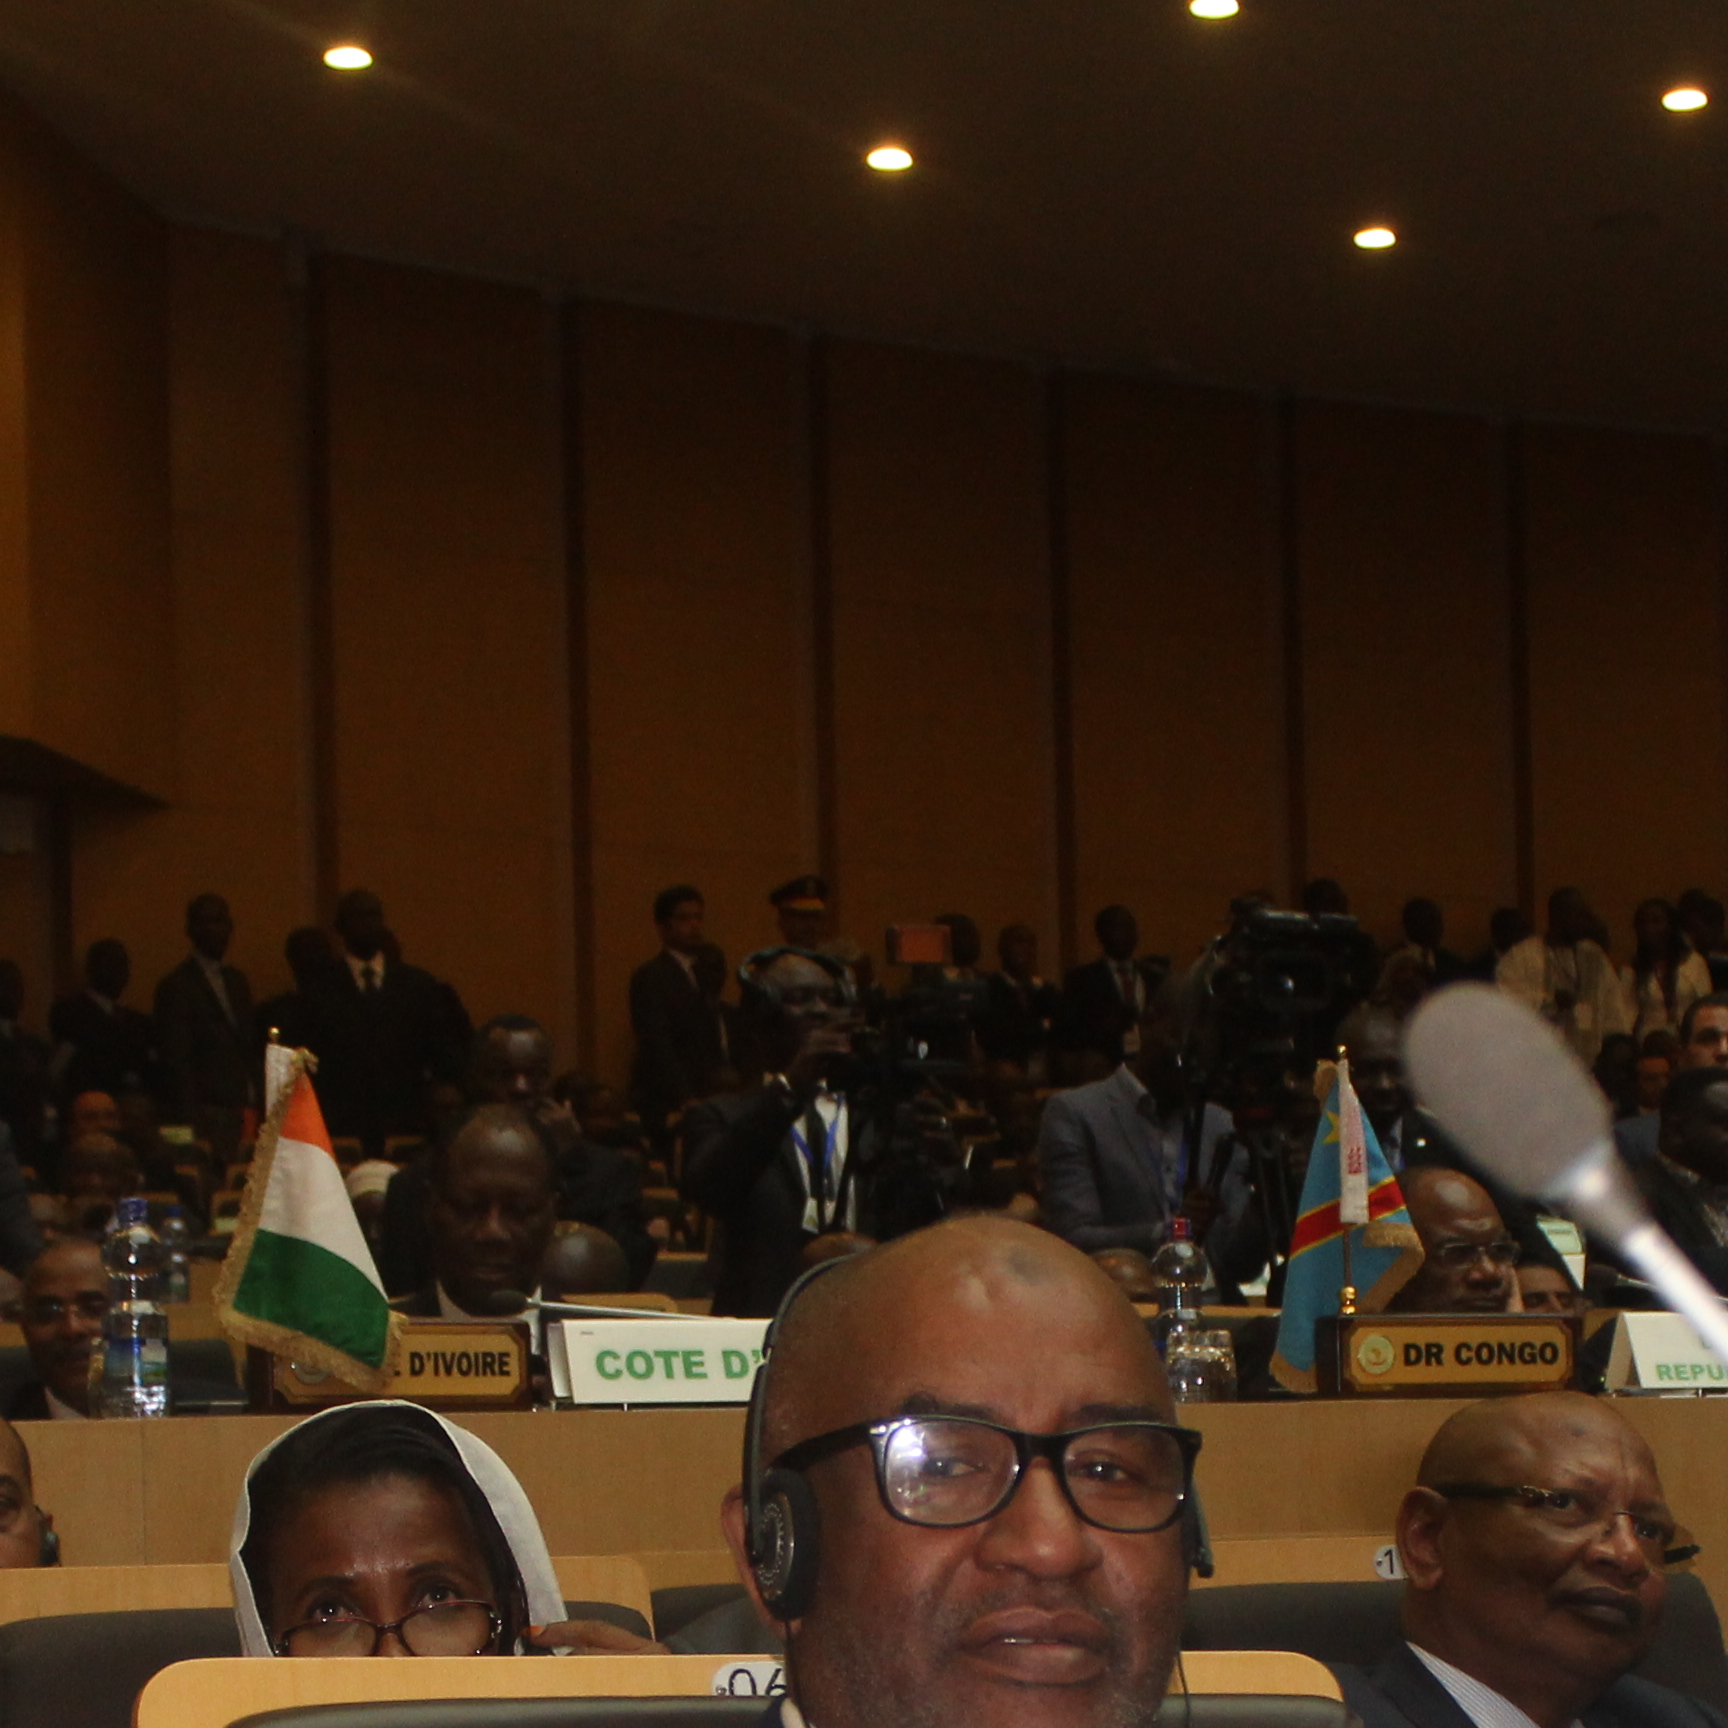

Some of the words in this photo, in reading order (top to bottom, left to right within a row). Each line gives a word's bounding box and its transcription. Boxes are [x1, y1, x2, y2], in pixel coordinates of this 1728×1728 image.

[409, 1351, 511, 1377] D'IVOIRE
[595, 1349, 708, 1380] COTE
[1403, 1343, 1444, 1367] DR
[1454, 1341, 1560, 1366] CONGO
